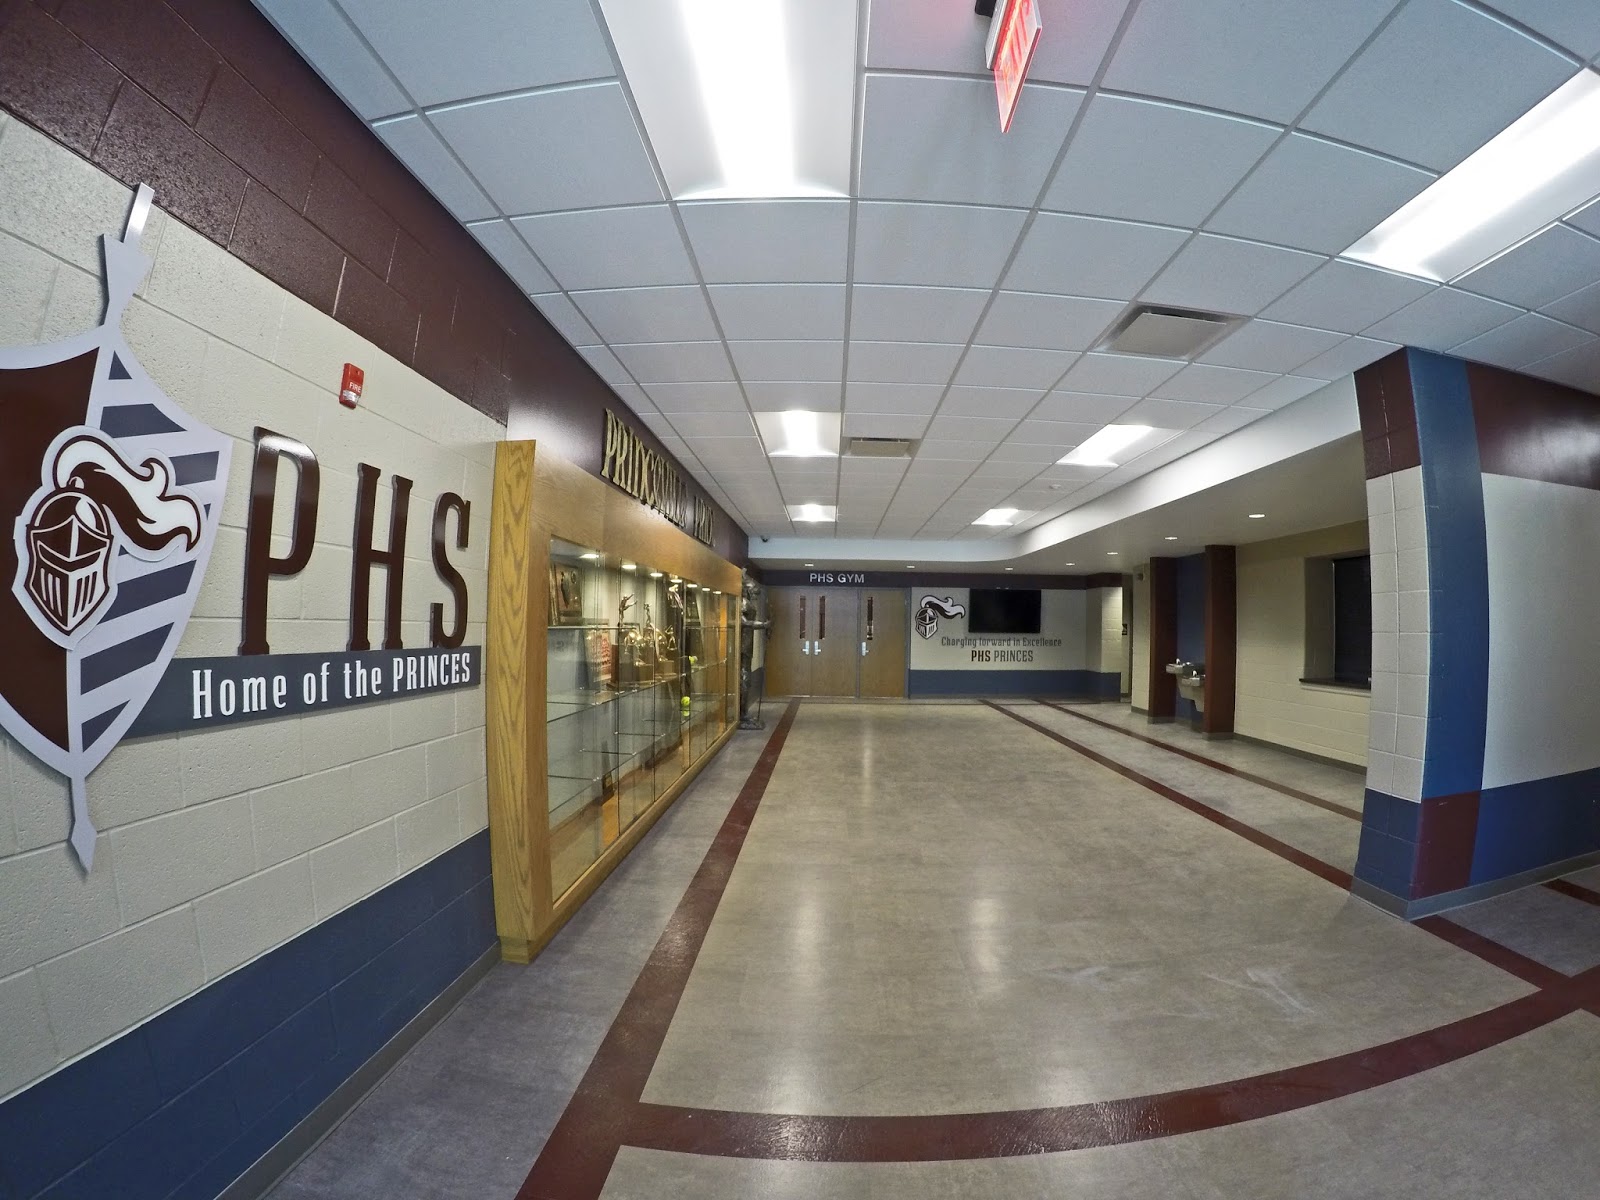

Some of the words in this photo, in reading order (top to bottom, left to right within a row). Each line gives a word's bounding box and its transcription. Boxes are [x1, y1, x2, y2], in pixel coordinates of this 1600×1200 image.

[349, 382, 361, 393] FIRE
[694, 496, 715, 547] PRID
[237, 426, 471, 655] PHS
[810, 573, 834, 583] PHS
[837, 573, 865, 583] GYM
[941, 636, 977, 648] Charging
[980, 637, 1011, 647] forward
[1013, 637, 1020, 647] in
[1022, 637, 1062, 647] Excellence
[971, 650, 991, 662] PHS
[993, 650, 1034, 662] PRINCES
[192, 669, 287, 720] Home
[303, 662, 330, 705] of
[343, 660, 382, 699] the
[393, 652, 471, 693] PRINCES
